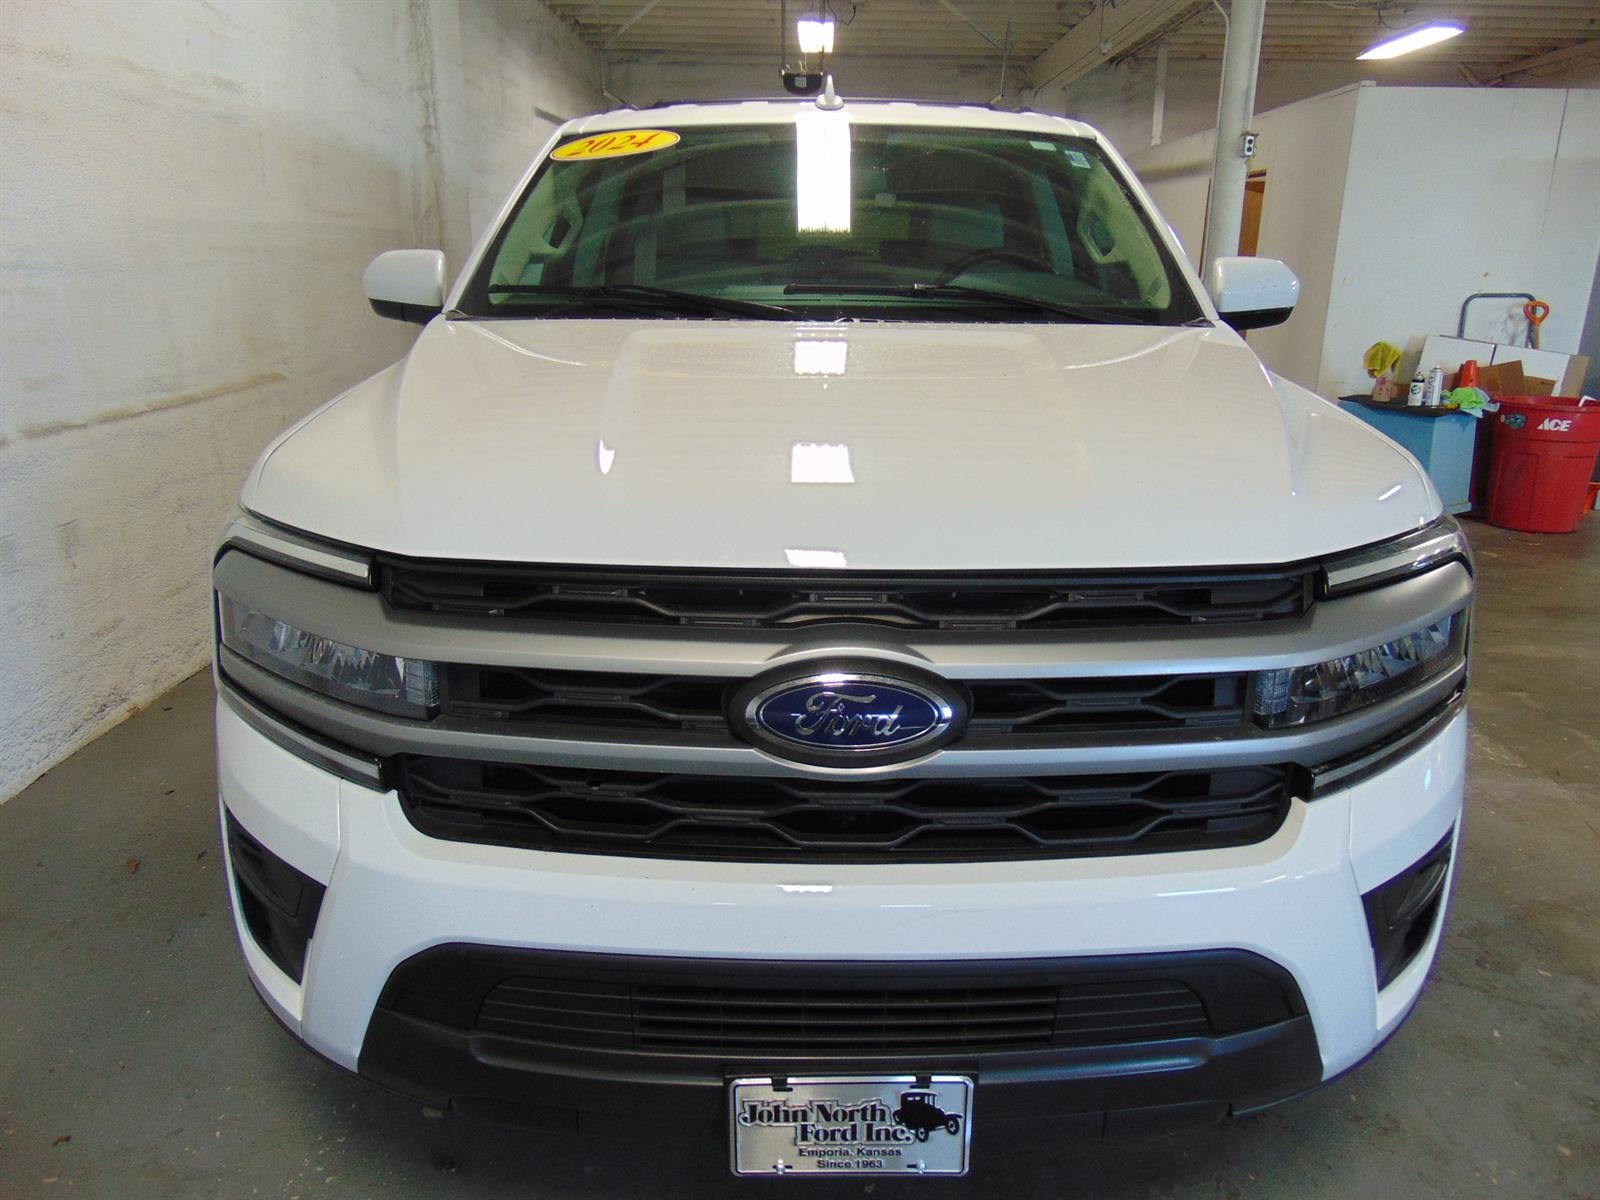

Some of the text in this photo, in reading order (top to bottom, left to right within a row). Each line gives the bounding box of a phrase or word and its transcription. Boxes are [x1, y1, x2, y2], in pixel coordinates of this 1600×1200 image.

[566, 132, 661, 157] 2024
[1537, 417, 1572, 432] ACE
[791, 691, 918, 737] Ford
[741, 1103, 887, 1124] John North
[800, 1123, 912, 1142] Ford Inc.
[857, 1148, 902, 1157] Kansas
[817, 1159, 883, 1168] Since 1963
